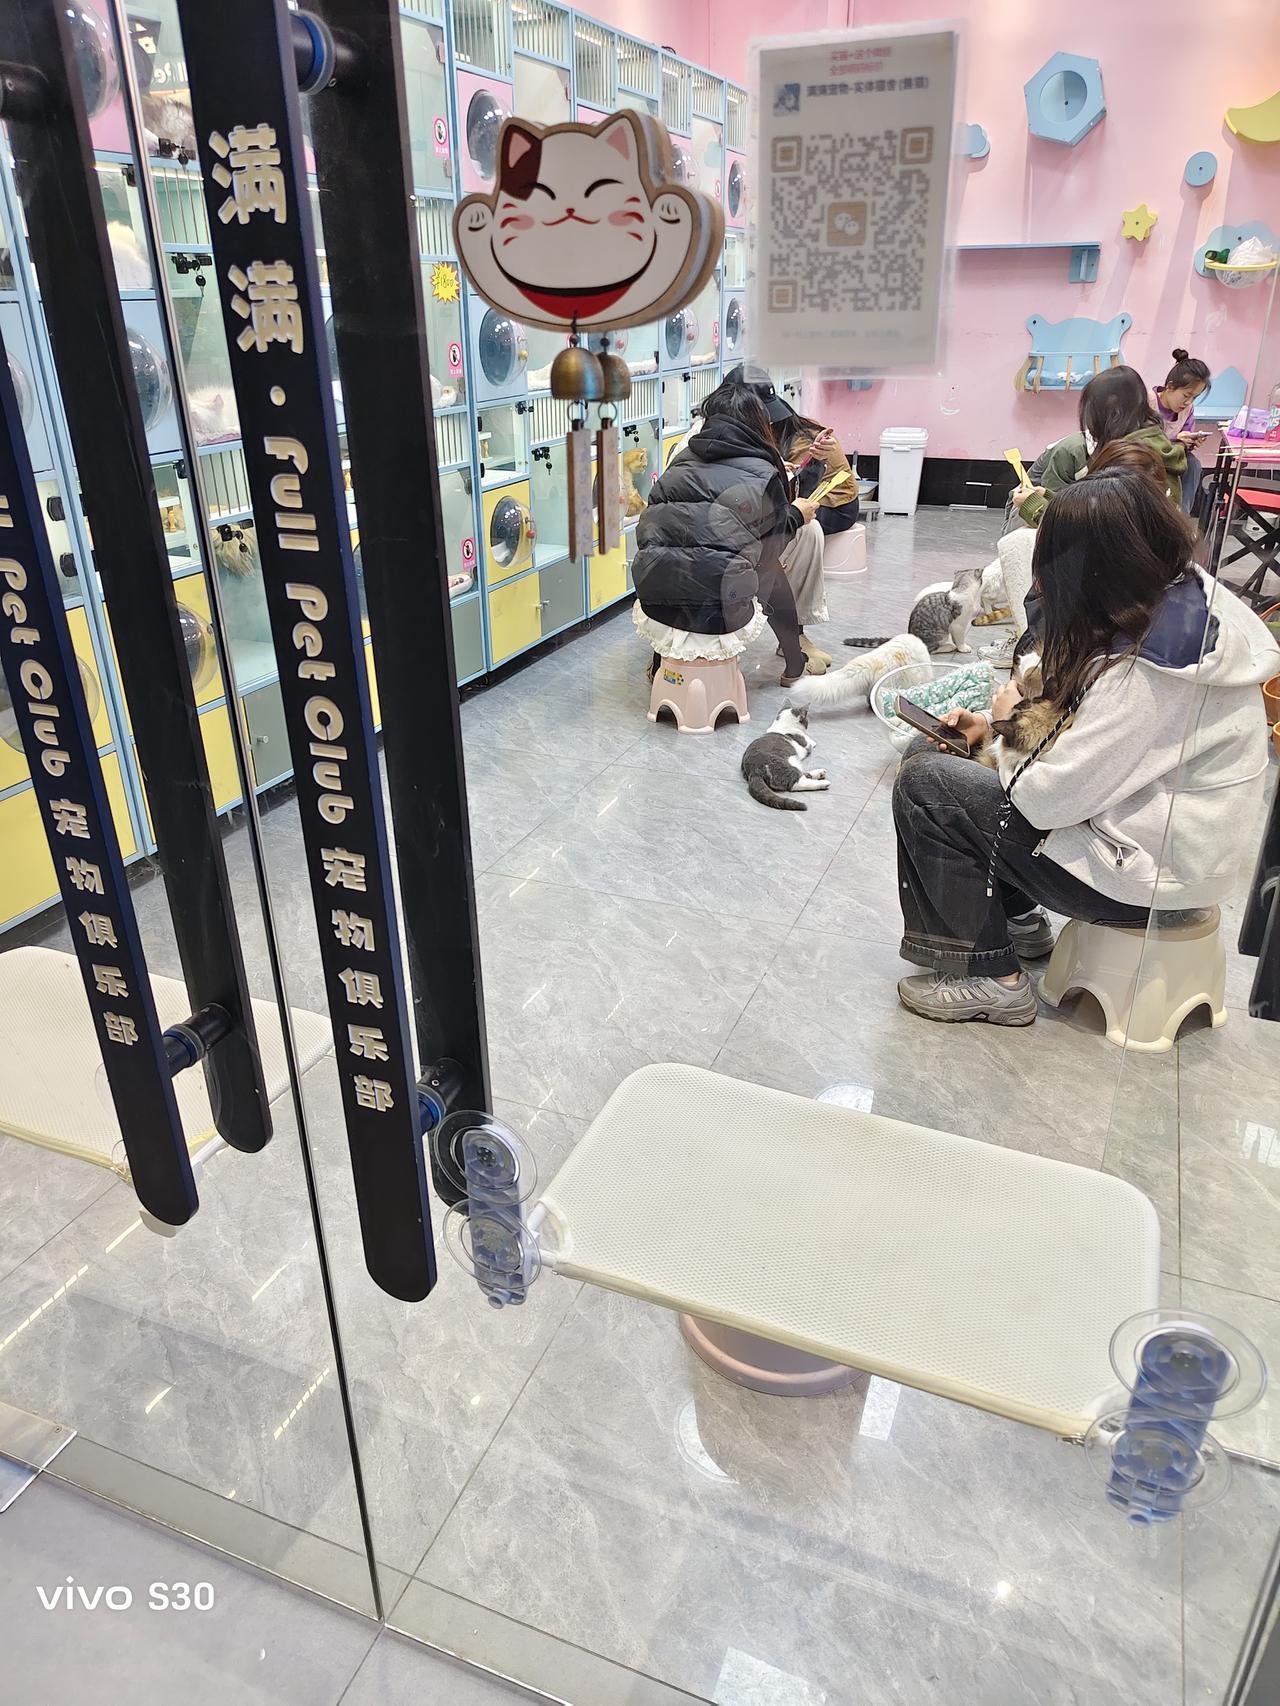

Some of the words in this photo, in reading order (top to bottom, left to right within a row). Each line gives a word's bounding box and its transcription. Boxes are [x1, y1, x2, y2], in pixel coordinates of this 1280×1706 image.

[263, 436, 320, 552] Full
[0, 557, 41, 645] Pet
[286, 581, 337, 682] Pet
[19, 658, 72, 778] Club
[303, 694, 355, 826] Club
[49, 798, 139, 1047] 宠物俱乐部
[320, 846, 395, 1113] 宠物俱乐部
